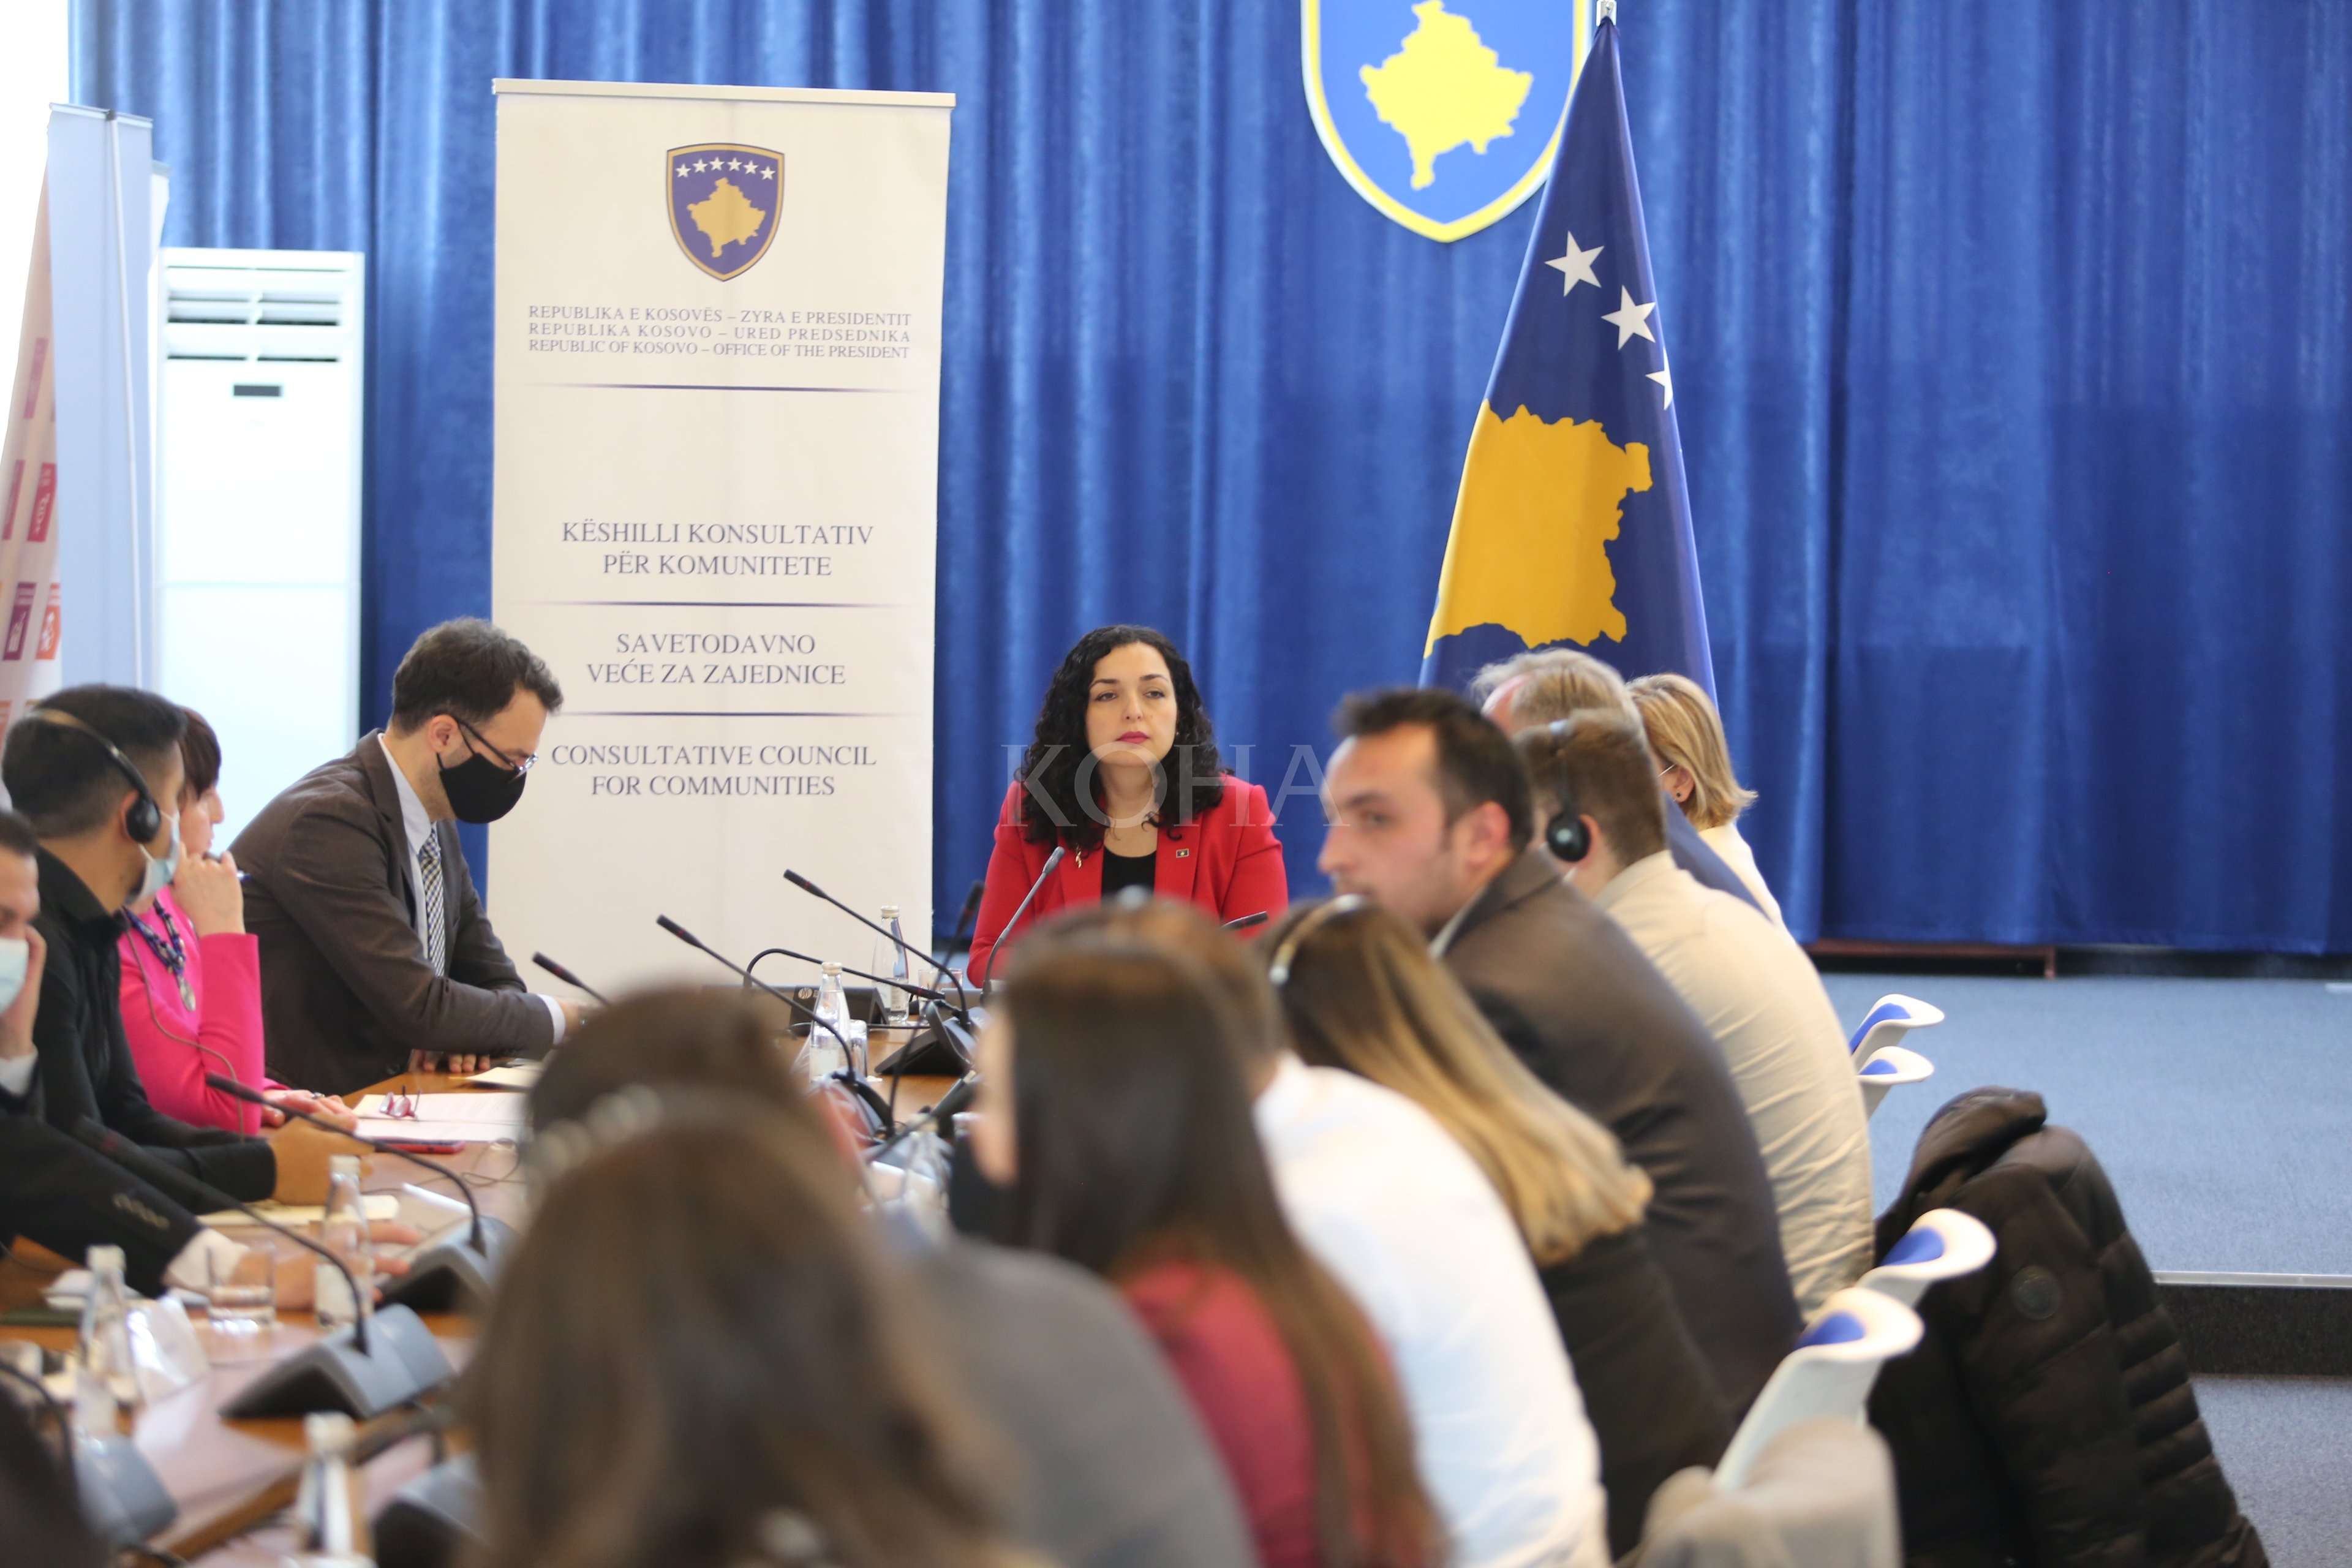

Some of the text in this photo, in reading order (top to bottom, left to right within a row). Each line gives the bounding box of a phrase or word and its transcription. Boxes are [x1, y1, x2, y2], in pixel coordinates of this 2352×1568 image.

[529, 305, 624, 320] REPUBLIKA
[630, 307, 639, 320] E
[645, 306, 722, 322] KOSOVËS
[741, 310, 786, 323] ZYRA
[791, 311, 801, 324] E
[806, 311, 911, 326] PRESIDENTIT
[529, 322, 630, 337] REPUBLIKA
[638, 325, 712, 339] KOSOVO
[734, 326, 782, 340] URED
[788, 328, 910, 342] PREDSEDNIKA
[529, 339, 606, 353] REPUBLIC
[608, 341, 629, 353] OF
[633, 341, 698, 355] KOSOVO
[713, 343, 767, 356] OFFICE
[770, 344, 791, 356] OF
[794, 344, 825, 357] THE
[829, 345, 909, 358] PRESIDENT
[562, 518, 874, 545] KËSHILLI KONSULTATIV
[603, 550, 832, 576] PËR KOMUNITETE
[616, 633, 816, 655] SAVETODAVNO
[586, 657, 846, 685] VEĆE ZA ZAJEDNICE
[551, 745, 877, 766] CONSULTATIVE COUNCIL
[591, 775, 835, 796] FOR COMMUNITIES
